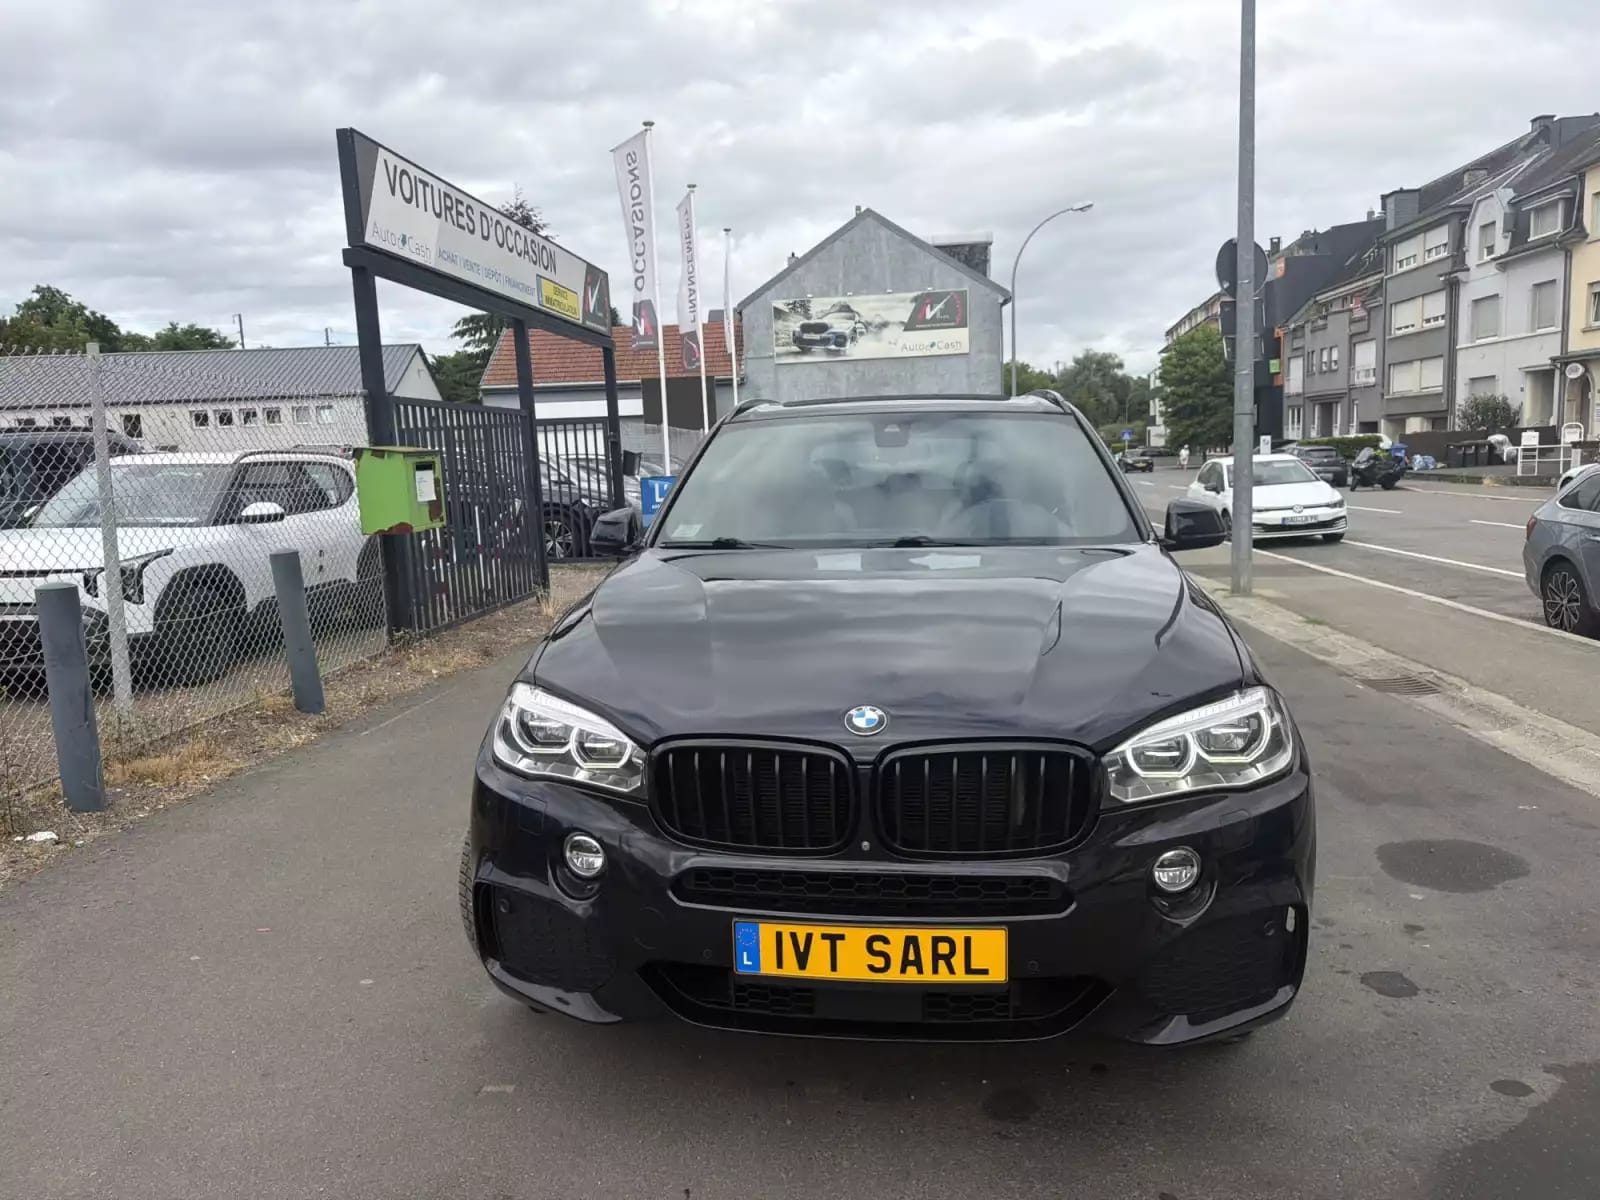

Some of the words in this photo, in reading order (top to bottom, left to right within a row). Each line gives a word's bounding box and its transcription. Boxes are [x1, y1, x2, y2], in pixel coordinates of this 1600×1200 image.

[383, 158, 476, 235] VOITURES
[480, 210, 557, 276] D'OCCASION
[743, 951, 752, 965] L
[775, 930, 846, 973] IVT
[865, 933, 990, 976] SARL
